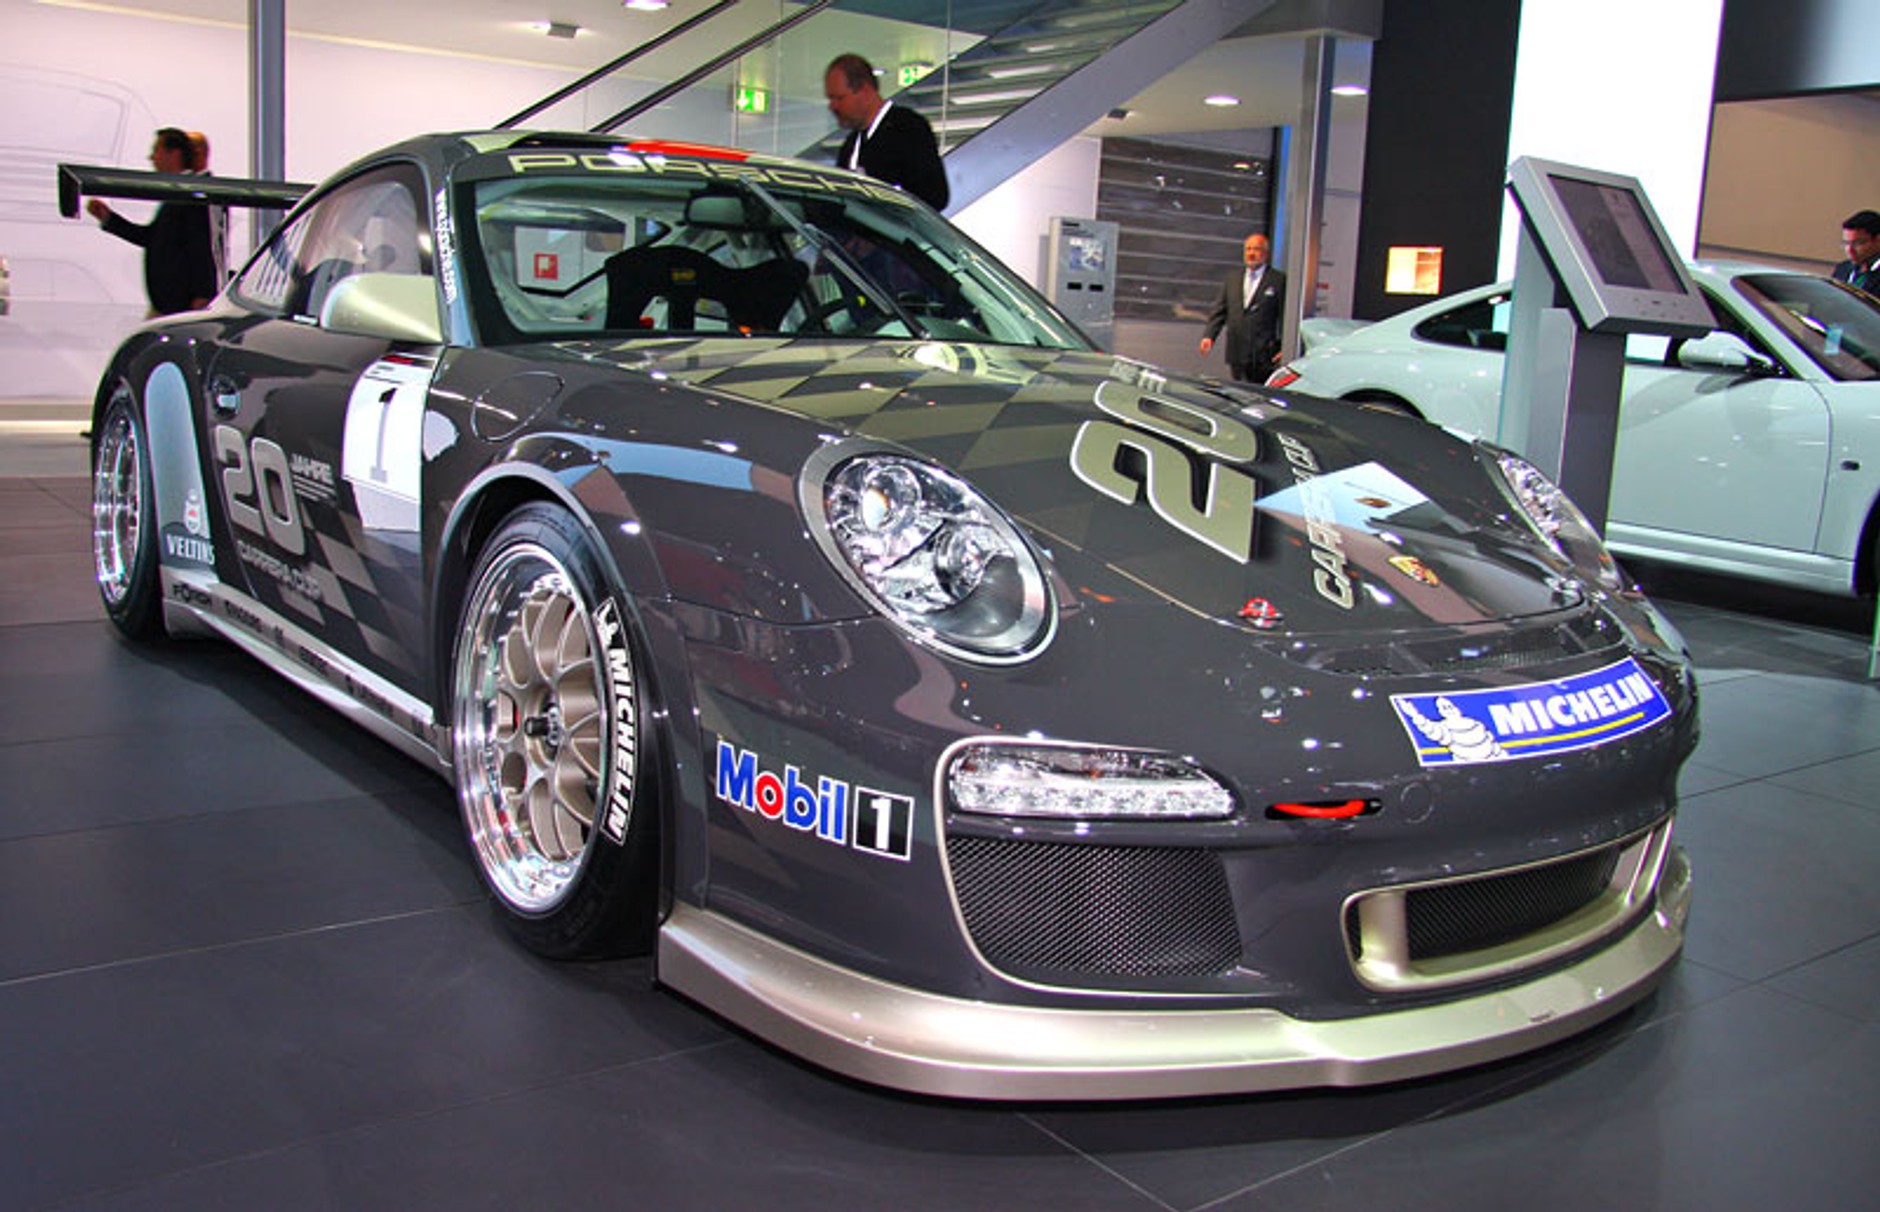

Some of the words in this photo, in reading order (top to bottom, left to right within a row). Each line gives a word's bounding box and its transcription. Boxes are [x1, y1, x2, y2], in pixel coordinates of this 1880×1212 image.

[508, 154, 915, 210] PORSCHE
[369, 387, 398, 483] 1
[1070, 380, 1256, 564] 20
[215, 424, 305, 556] 20
[166, 534, 215, 565] VELTINS
[607, 648, 636, 840] MICHELIN
[1487, 672, 1655, 736] MICHELIN
[716, 740, 849, 845] Mobil
